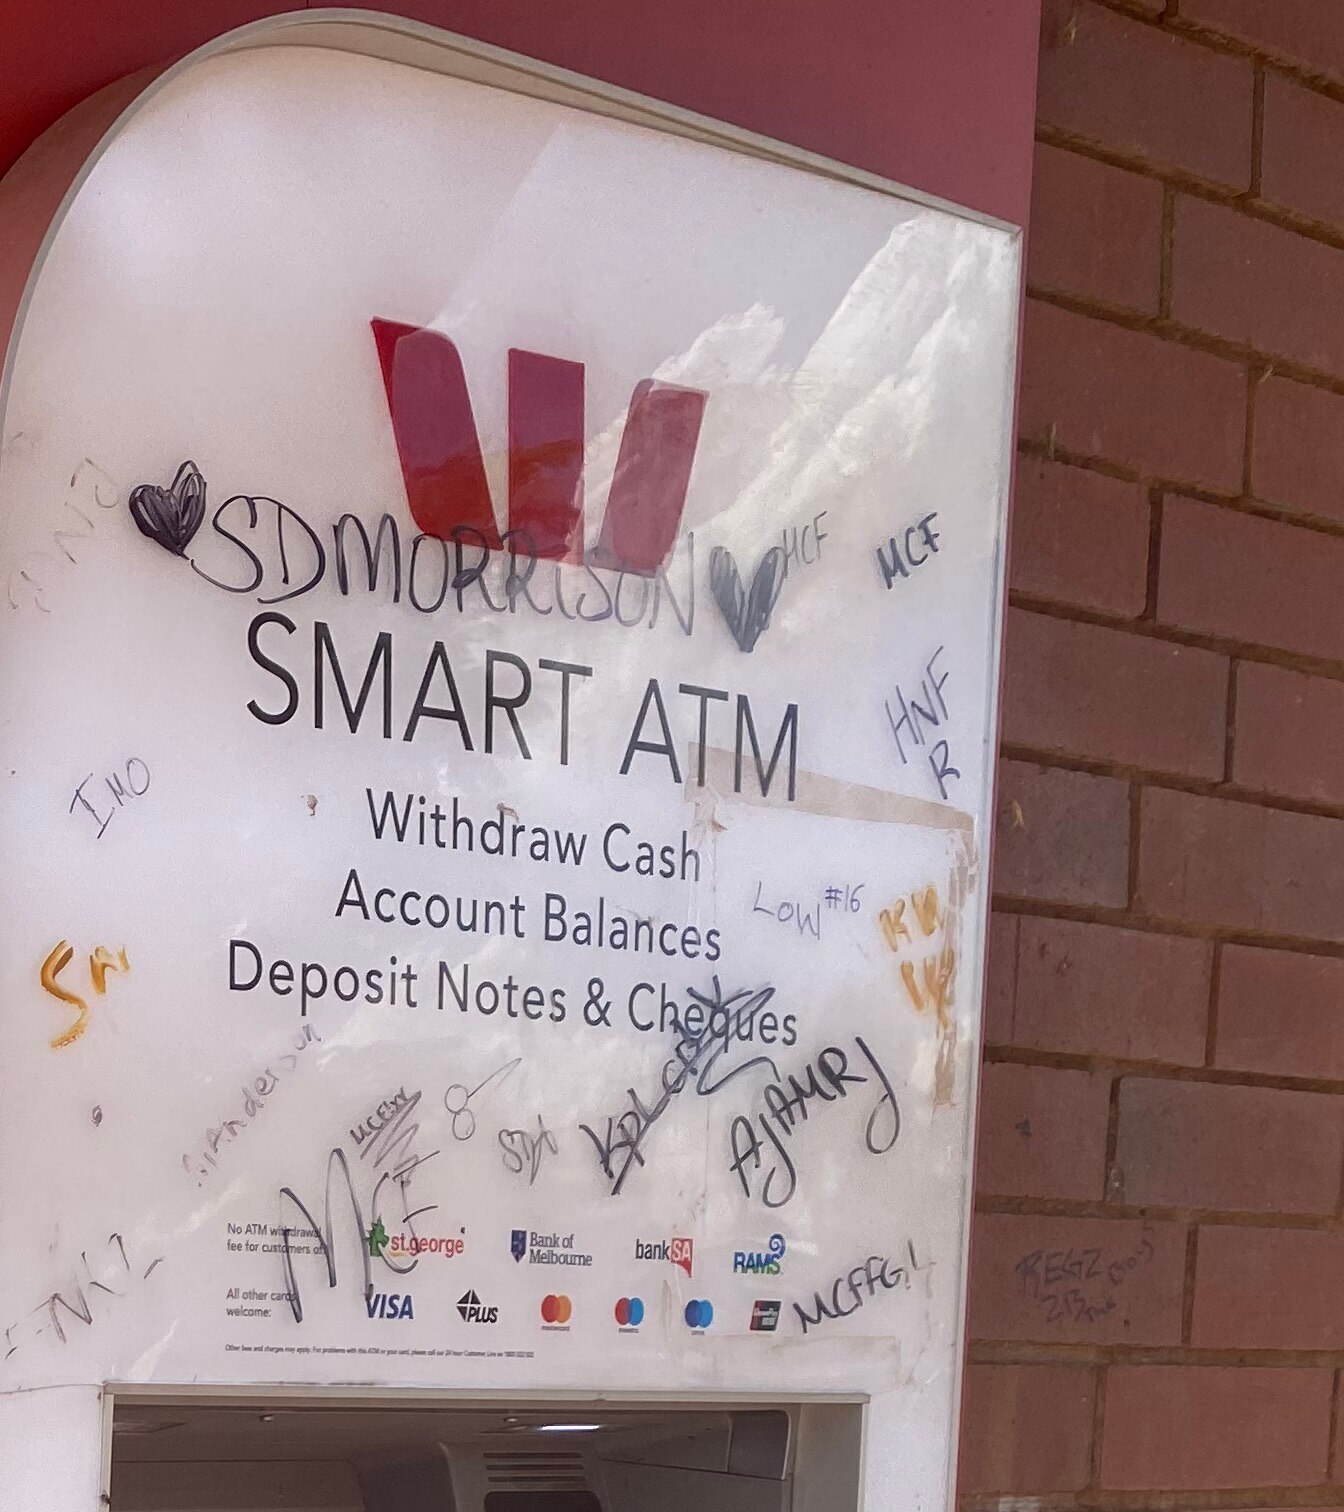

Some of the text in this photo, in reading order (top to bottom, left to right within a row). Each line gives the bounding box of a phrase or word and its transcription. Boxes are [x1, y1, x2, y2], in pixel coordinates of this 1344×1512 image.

[246, 611, 800, 802] SMART ATM
[366, 788, 700, 881] Withdraw Cash
[334, 868, 722, 961] Account Balances
[228, 939, 798, 1053] Deposit Notes & Cheques
[227, 1222, 242, 1235] No
[245, 1224, 267, 1236] ATM
[530, 1231, 575, 1249] Bank of
[227, 1239, 242, 1252] fee
[245, 1240, 259, 1252] for
[262, 1243, 310, 1255] customers
[390, 1233, 464, 1258] st.george
[635, 1238, 693, 1263] bankSA
[529, 1249, 592, 1267] Melbourne
[733, 1252, 781, 1275] RAMS
[226, 1287, 239, 1300] All
[242, 1289, 268, 1301] other
[226, 1305, 272, 1318] welcome:
[367, 1294, 414, 1320] VISA
[468, 1306, 499, 1324] PLUS
